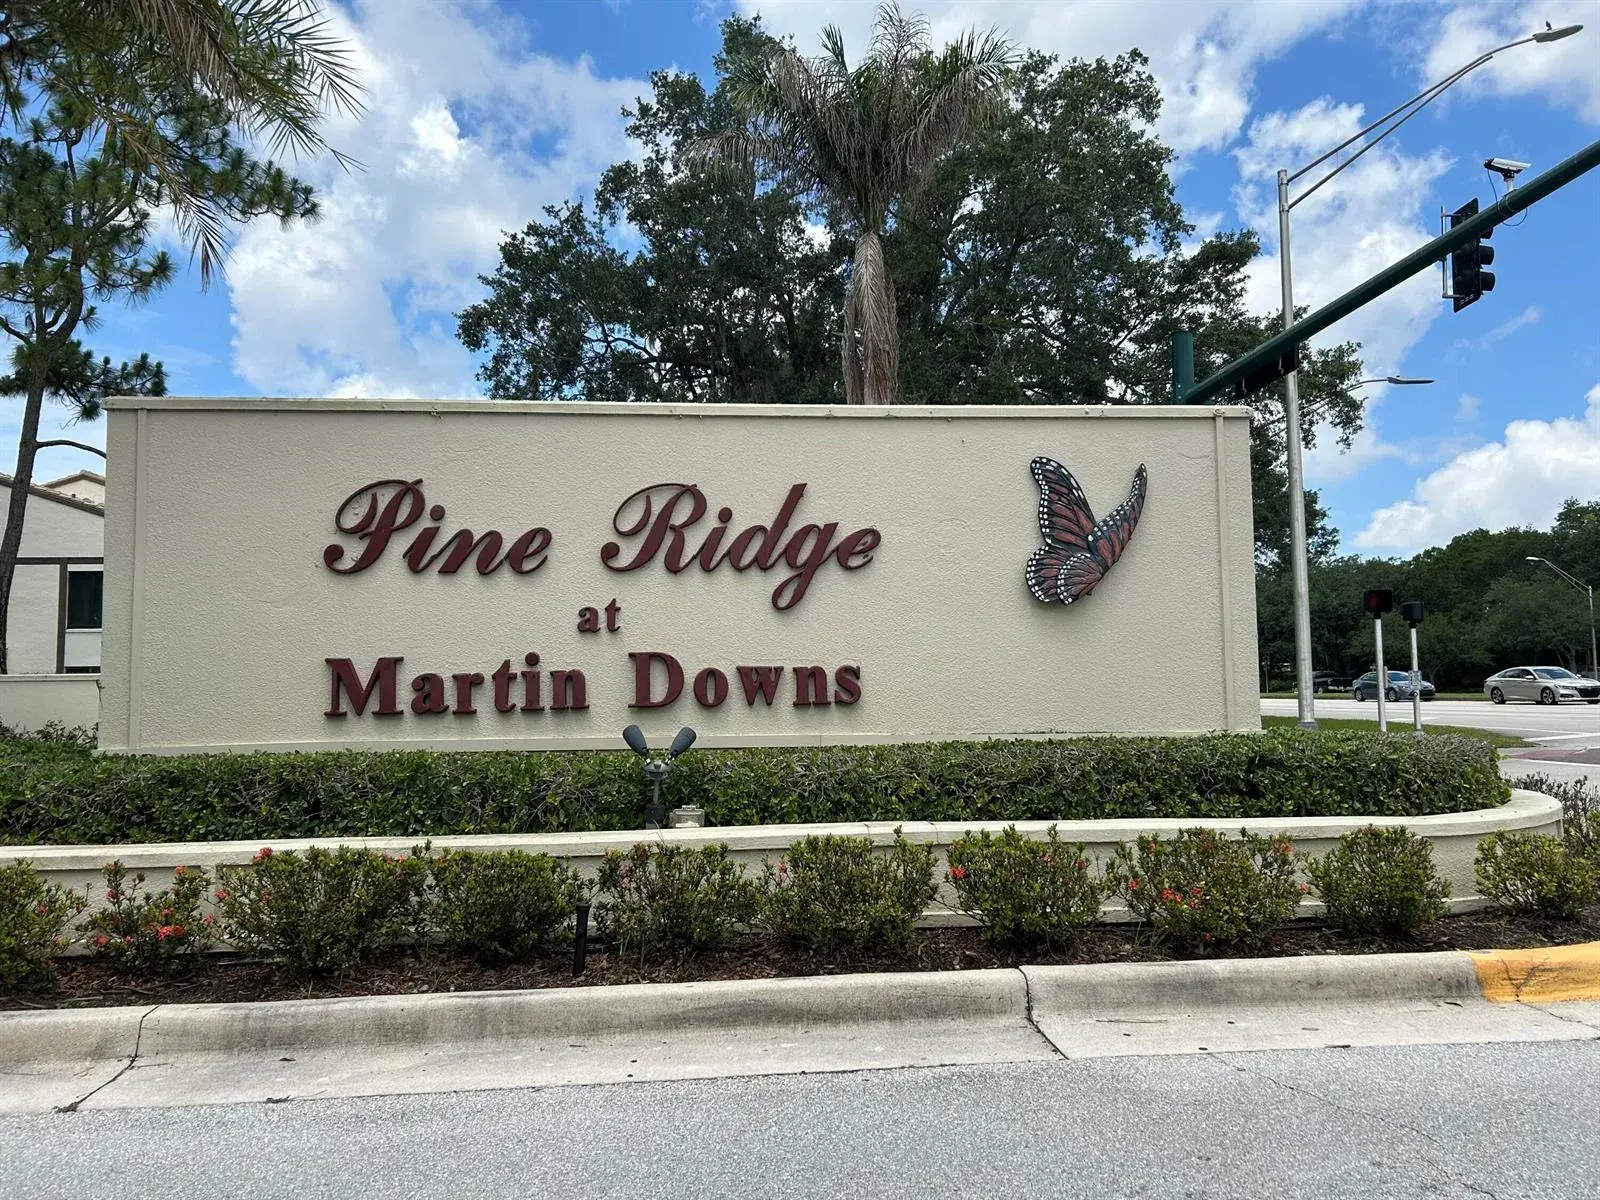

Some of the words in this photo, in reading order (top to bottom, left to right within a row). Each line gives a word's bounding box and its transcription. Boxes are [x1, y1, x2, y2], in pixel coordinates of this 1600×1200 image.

[323, 478, 553, 576] Pine
[600, 483, 881, 611] Ridge
[577, 598, 621, 633] at
[324, 652, 590, 717] Martin
[627, 652, 861, 708] Downs
